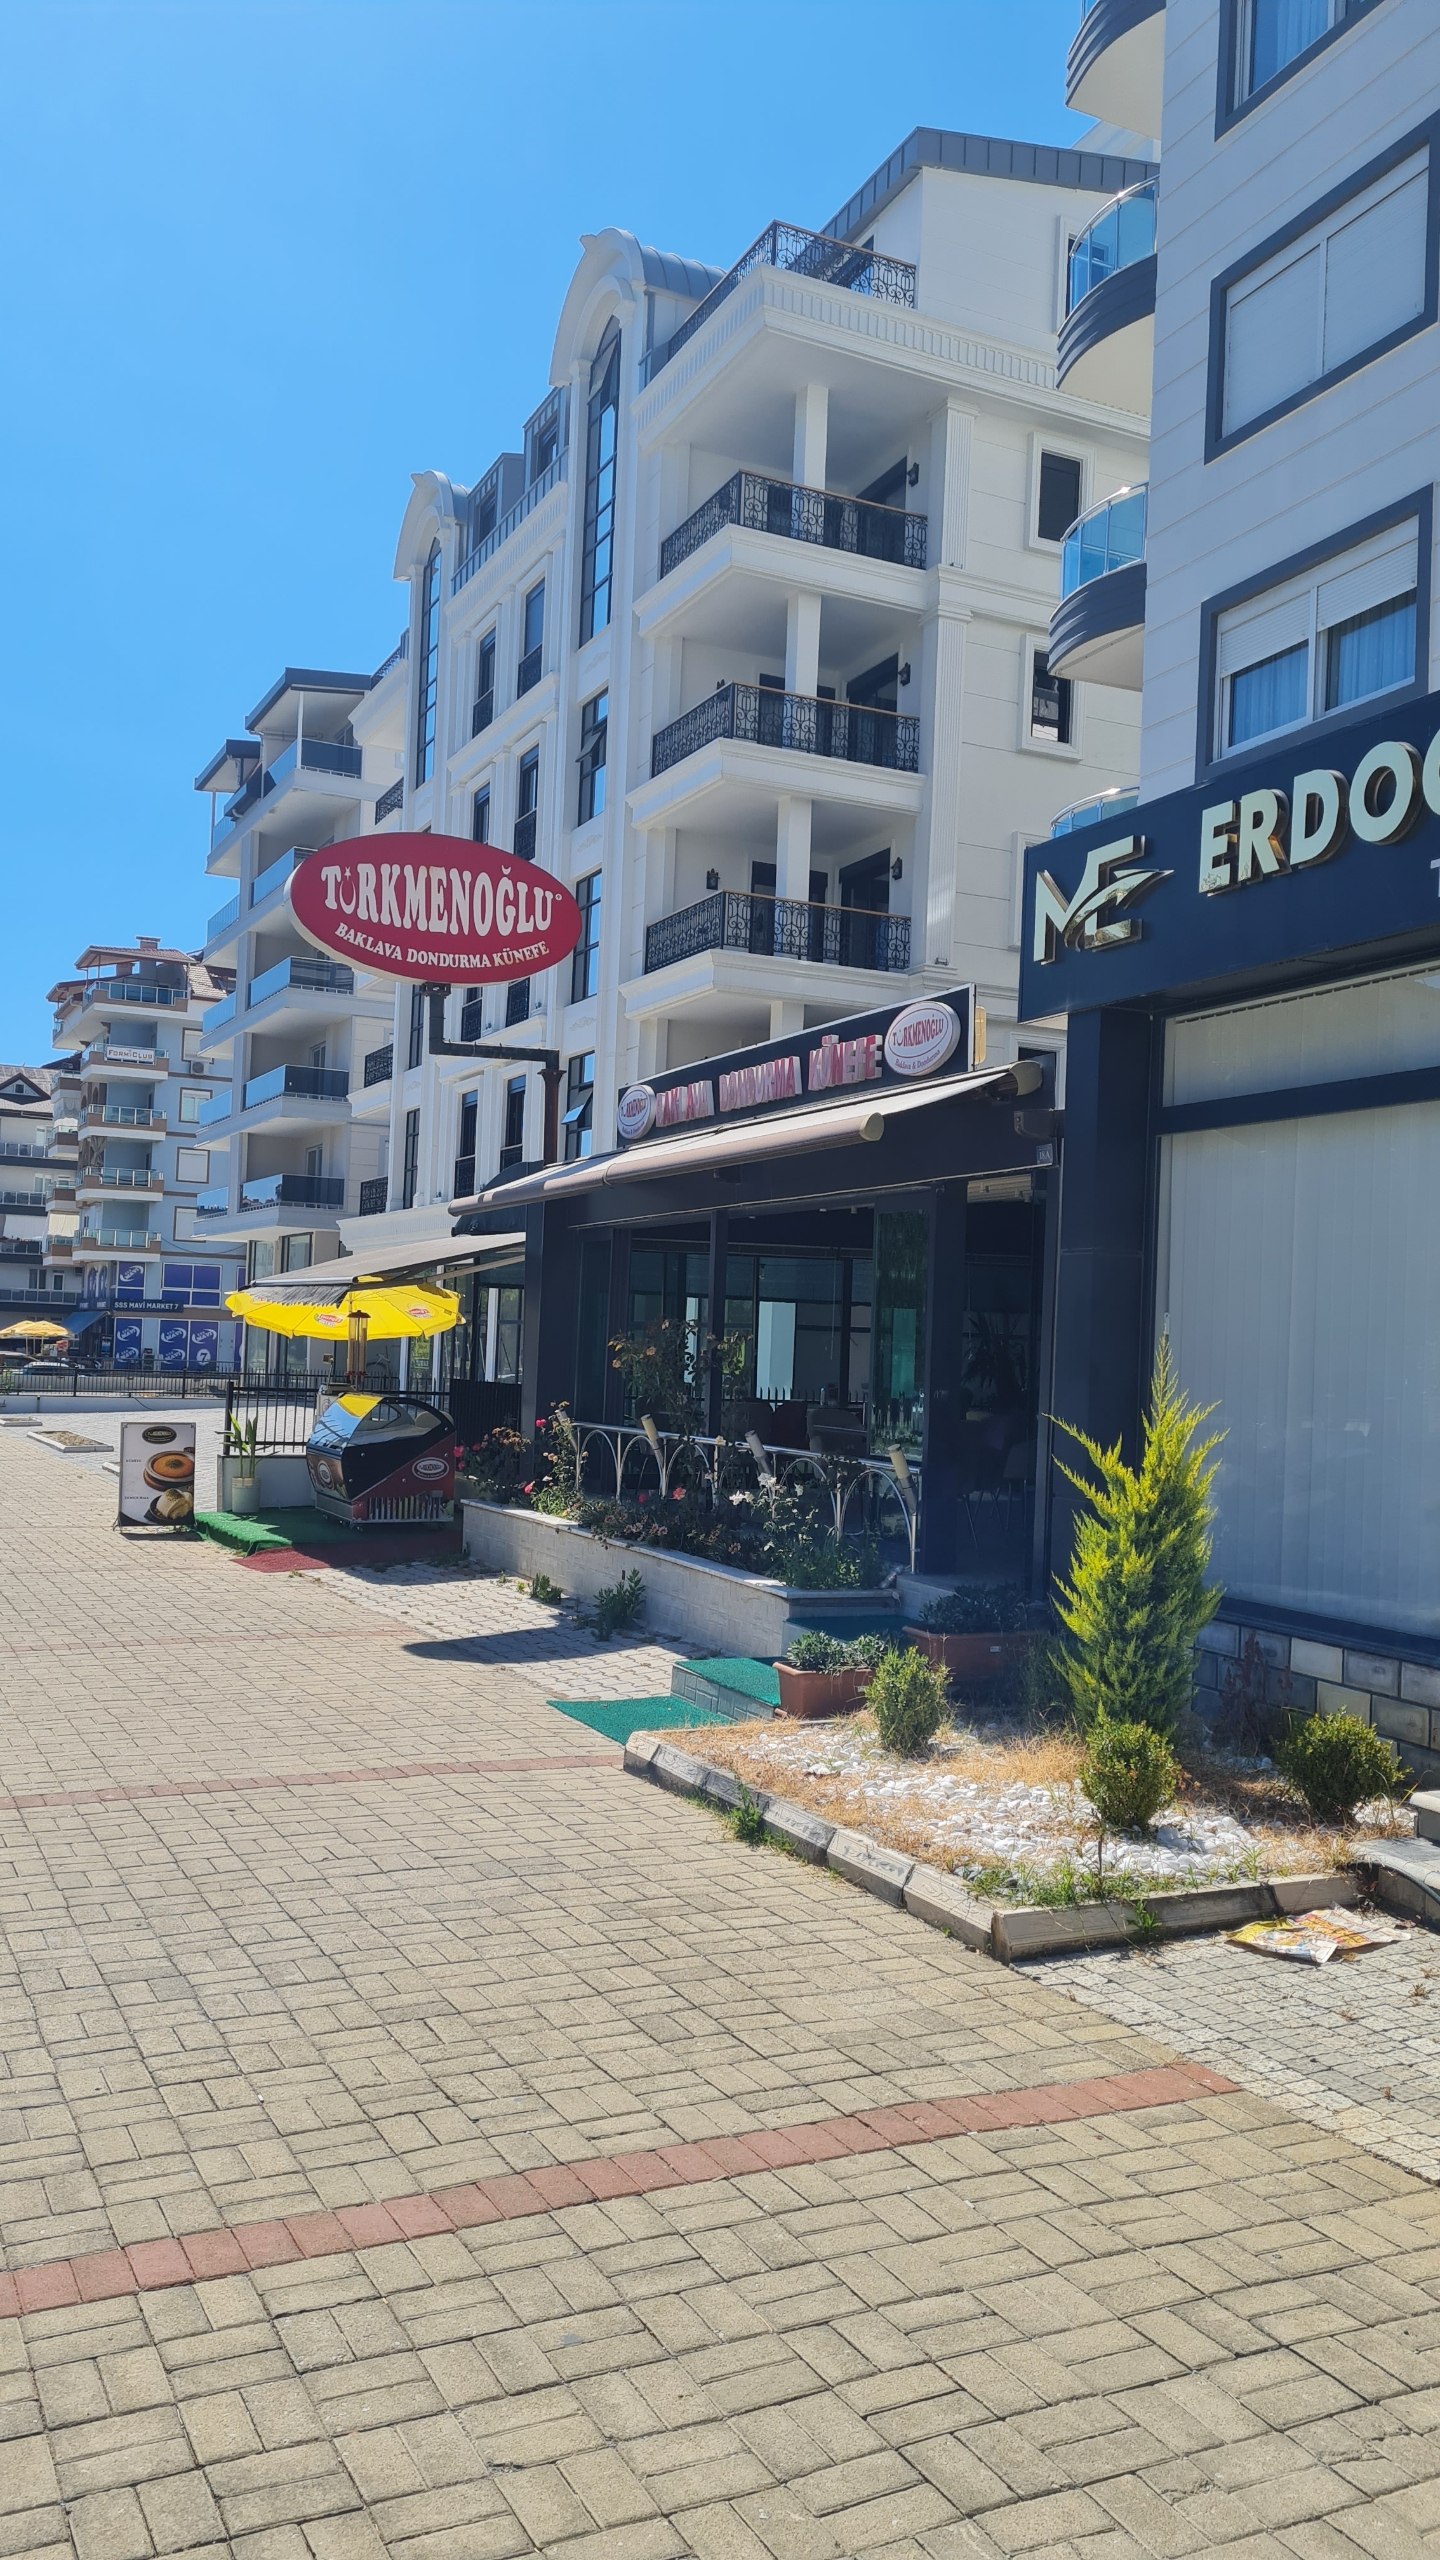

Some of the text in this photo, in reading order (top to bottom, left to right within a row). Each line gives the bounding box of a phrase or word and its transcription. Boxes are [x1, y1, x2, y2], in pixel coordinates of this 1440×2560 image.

[334, 922, 550, 969] BAKLAVA DONDURMA KÜNEFE
[146, 1302, 173, 1310] MARKET
[200, 1352, 208, 1364] 7
